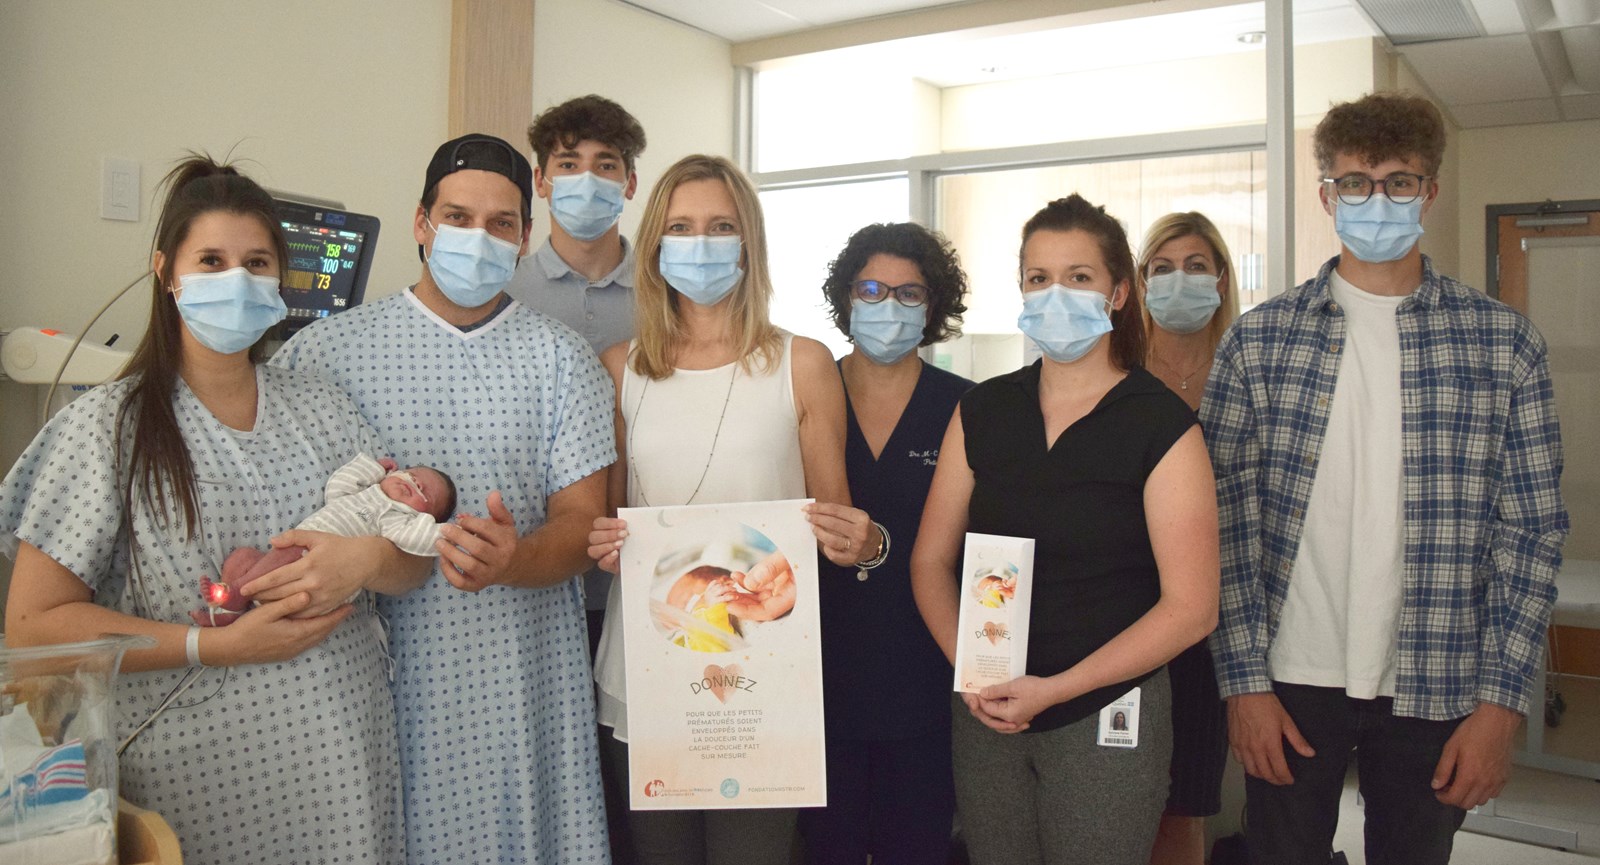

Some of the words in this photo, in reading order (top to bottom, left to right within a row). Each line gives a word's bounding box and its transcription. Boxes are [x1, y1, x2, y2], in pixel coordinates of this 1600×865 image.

[326, 244, 341, 258] 158
[322, 258, 339, 274] 100
[318, 274, 331, 290] 73
[690, 675, 757, 694] DONNEZ
[687, 717, 735, 726] PRÉMATURÉS
[704, 735, 737, 743] DOUCEUR
